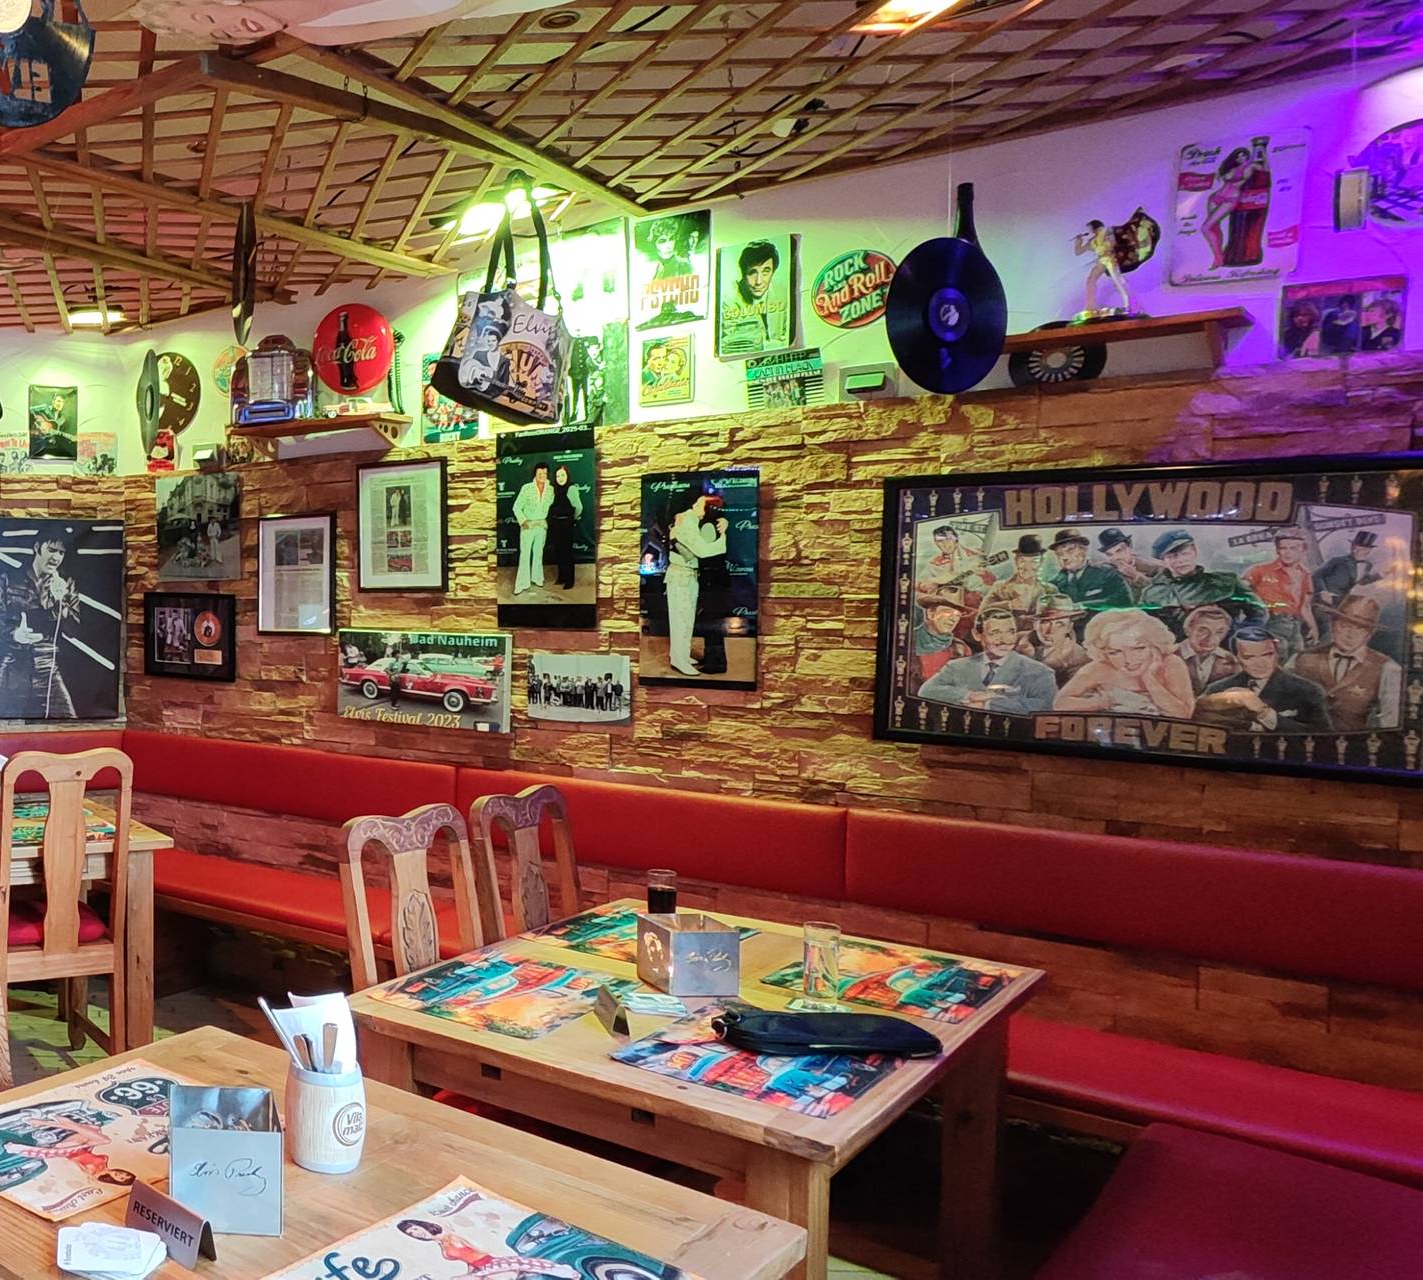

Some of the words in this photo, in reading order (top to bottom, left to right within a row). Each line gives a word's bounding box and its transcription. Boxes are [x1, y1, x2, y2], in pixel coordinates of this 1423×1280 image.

[816, 284, 850, 316] And
[848, 260, 894, 298] Roll
[824, 251, 868, 291] ROCK
[512, 314, 553, 336] Elvis
[839, 288, 884, 325] ZONE
[1004, 481, 1293, 526] HOLLYWOOD
[409, 634, 434, 645] Bad
[438, 635, 498, 647] Nauheim
[341, 705, 372, 721] Elvis
[376, 708, 423, 726] Festival
[428, 712, 463, 729] 2023
[1035, 716, 1227, 754] FOREVER
[113, 1081, 160, 1100] 66
[133, 1200, 195, 1248] RESERVIERT
